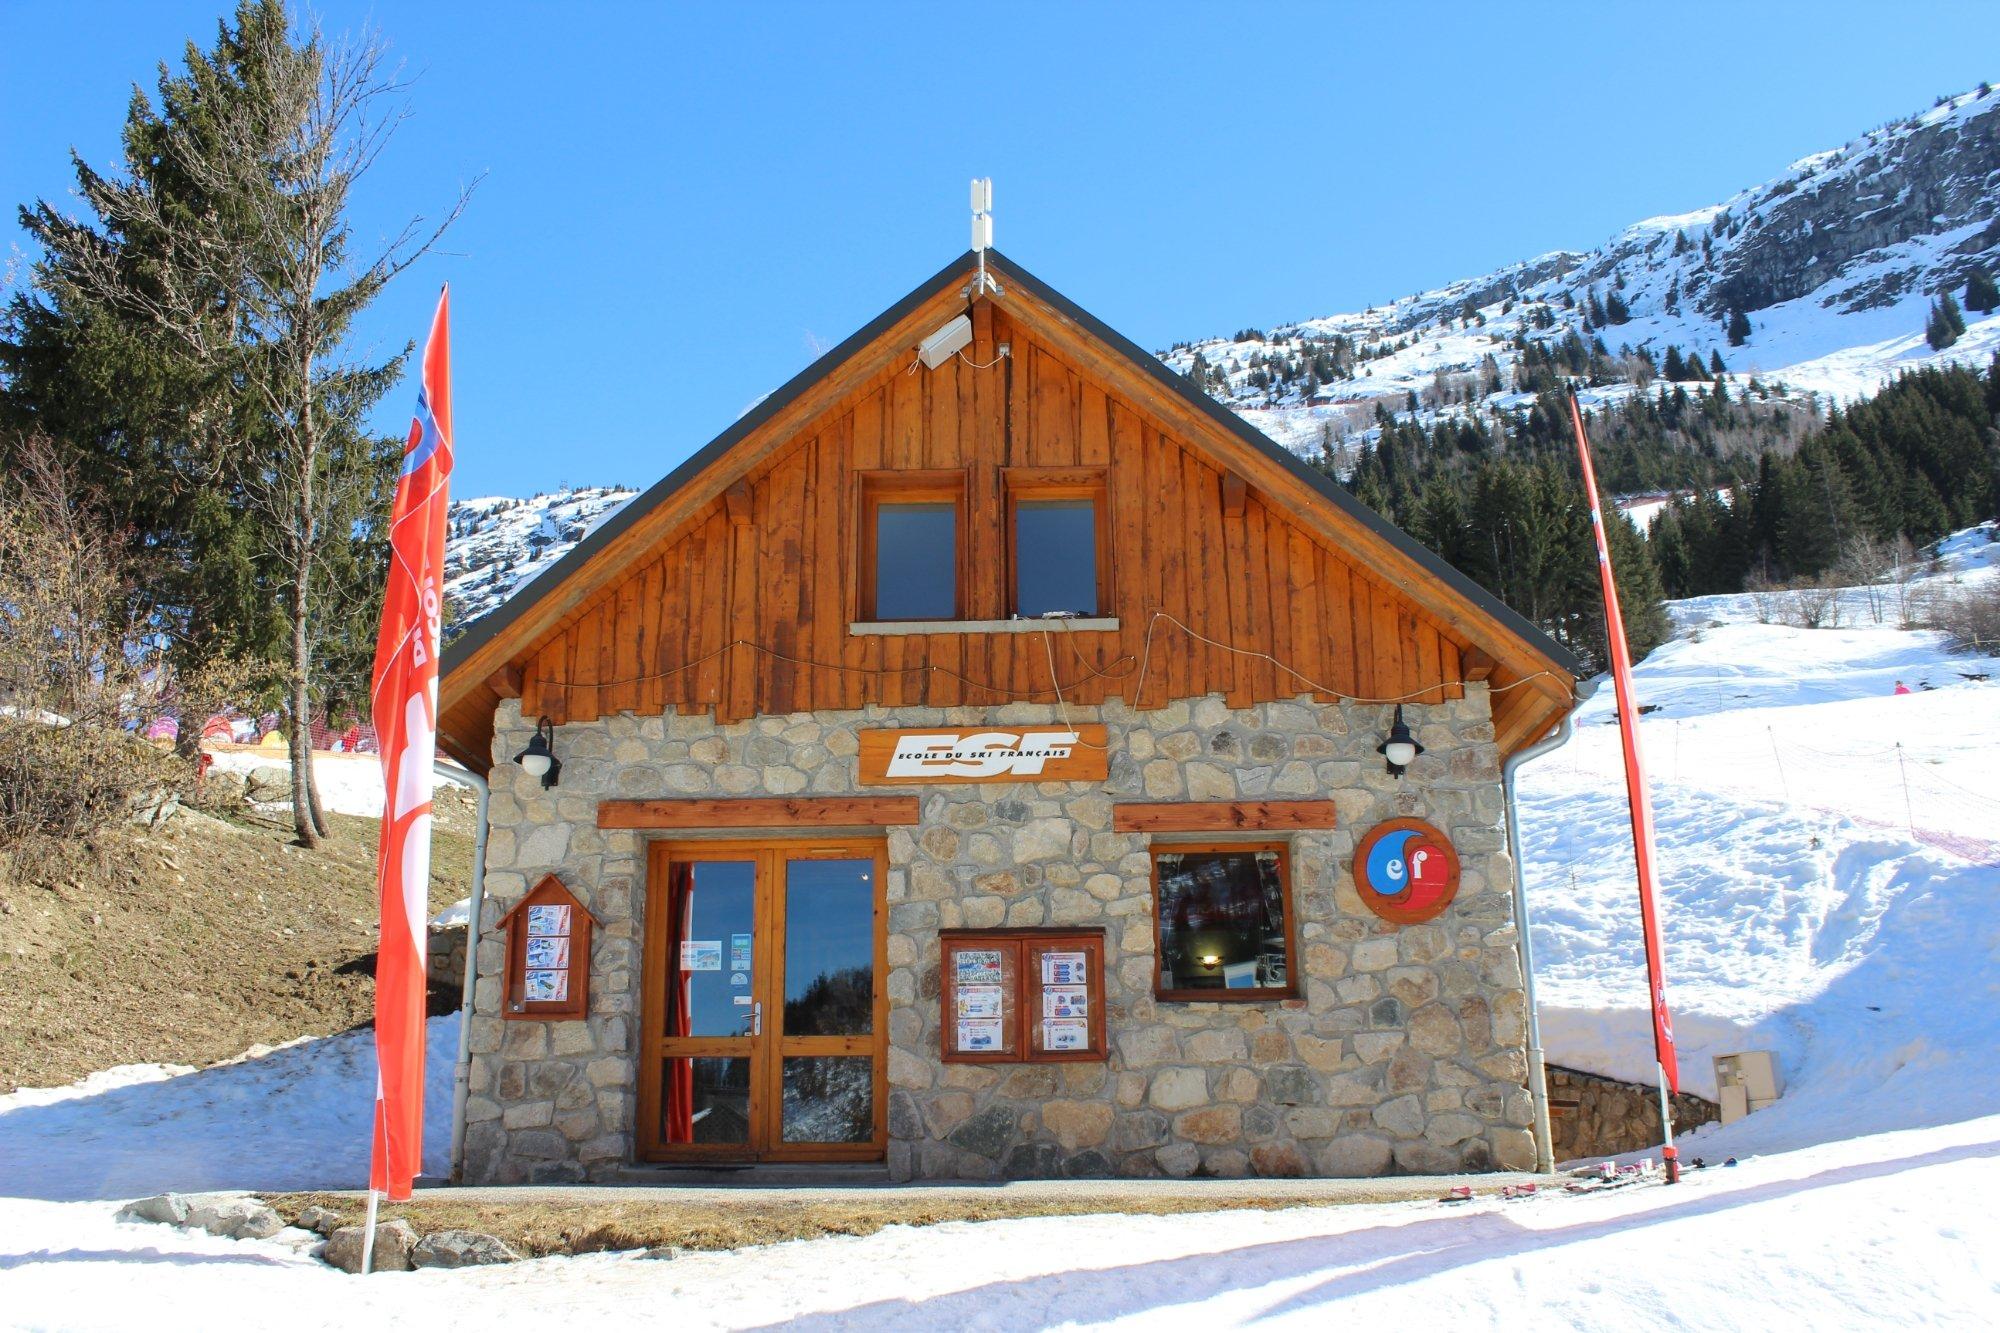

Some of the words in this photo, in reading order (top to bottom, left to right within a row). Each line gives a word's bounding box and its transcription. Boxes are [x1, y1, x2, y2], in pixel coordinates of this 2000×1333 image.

[886, 732, 1080, 777] ESF
[898, 752, 938, 760] ECOLE
[945, 751, 963, 759] DU
[970, 751, 993, 759] SKI
